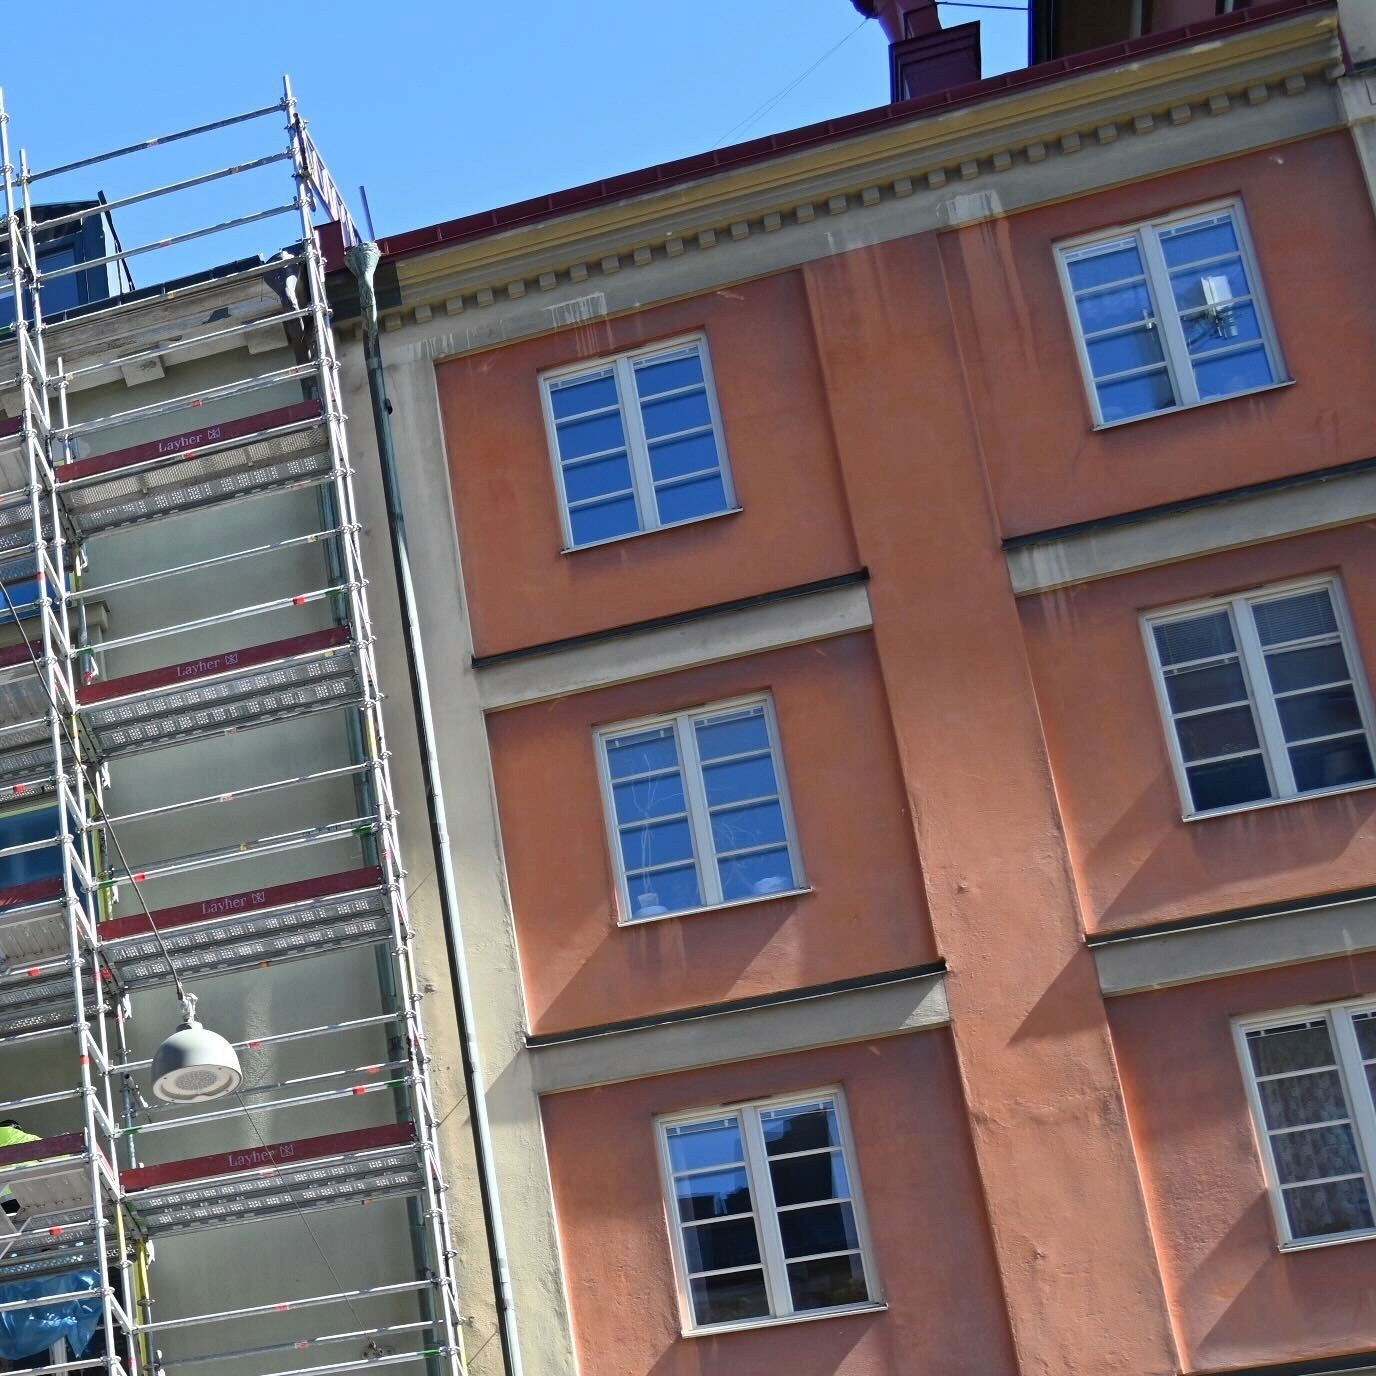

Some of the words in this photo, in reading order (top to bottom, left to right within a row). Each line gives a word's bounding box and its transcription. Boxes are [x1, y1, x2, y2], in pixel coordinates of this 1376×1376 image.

[159, 434, 202, 452] Layher
[176, 660, 220, 677] Layher
[202, 896, 246, 914] Layher
[228, 1149, 274, 1166] Layher
